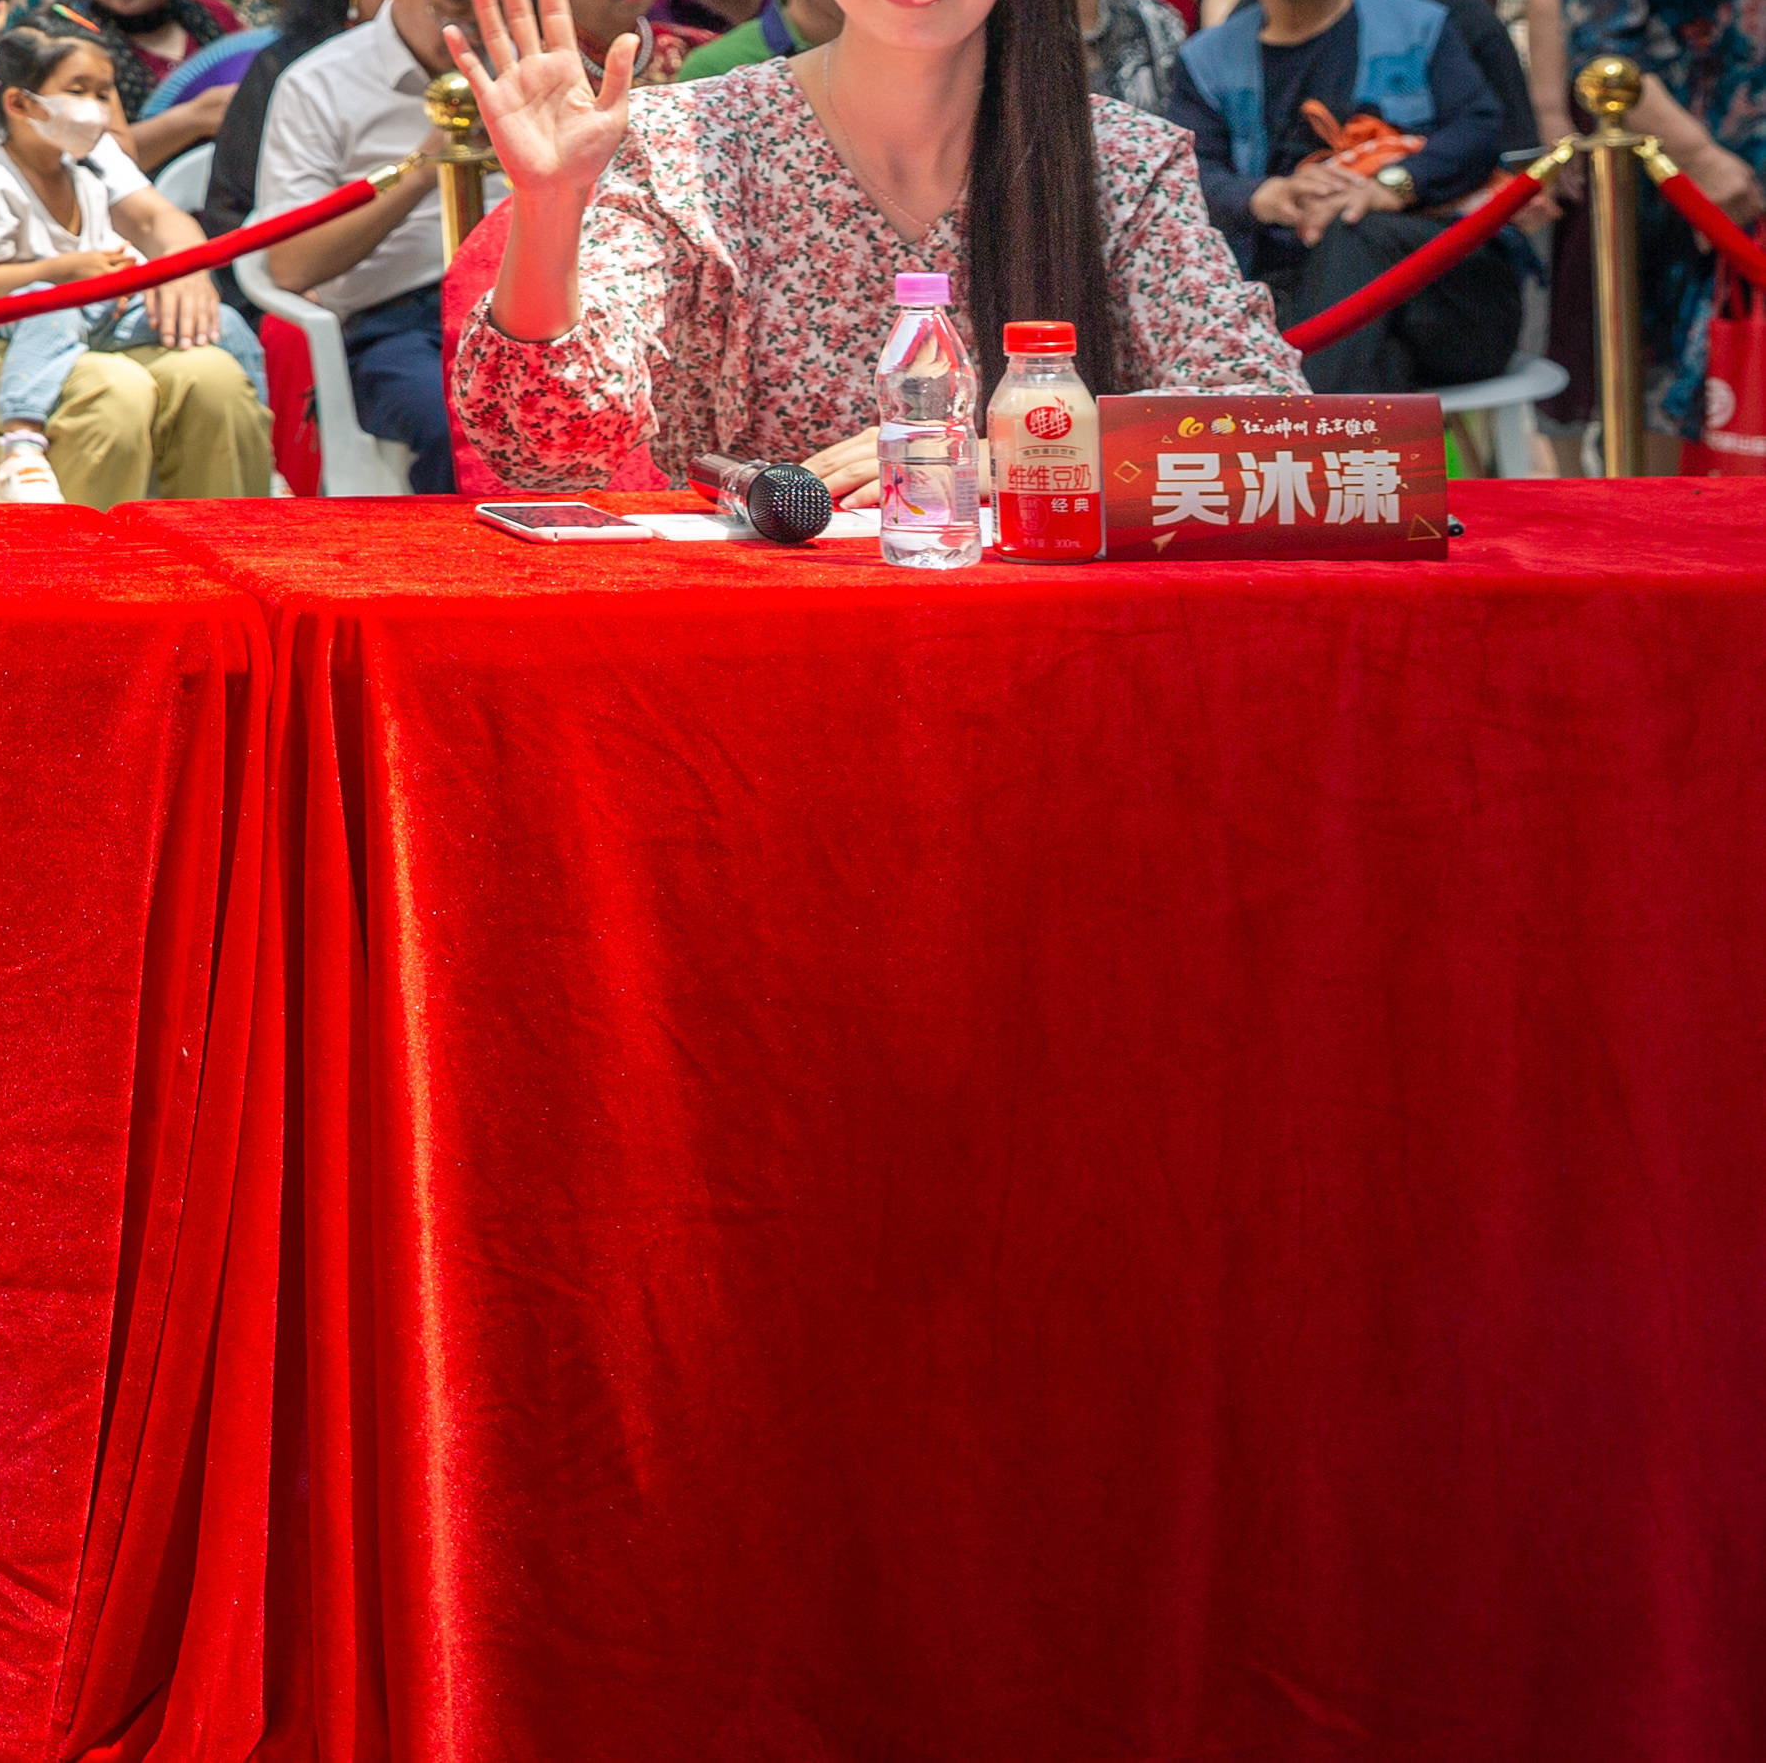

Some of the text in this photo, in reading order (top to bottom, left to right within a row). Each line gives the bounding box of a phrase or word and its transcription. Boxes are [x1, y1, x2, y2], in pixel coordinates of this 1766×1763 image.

[1008, 464, 1092, 491] 维维豆奶
[1151, 449, 1402, 526] 吴沐潇
[1051, 497, 1089, 514] 经典
